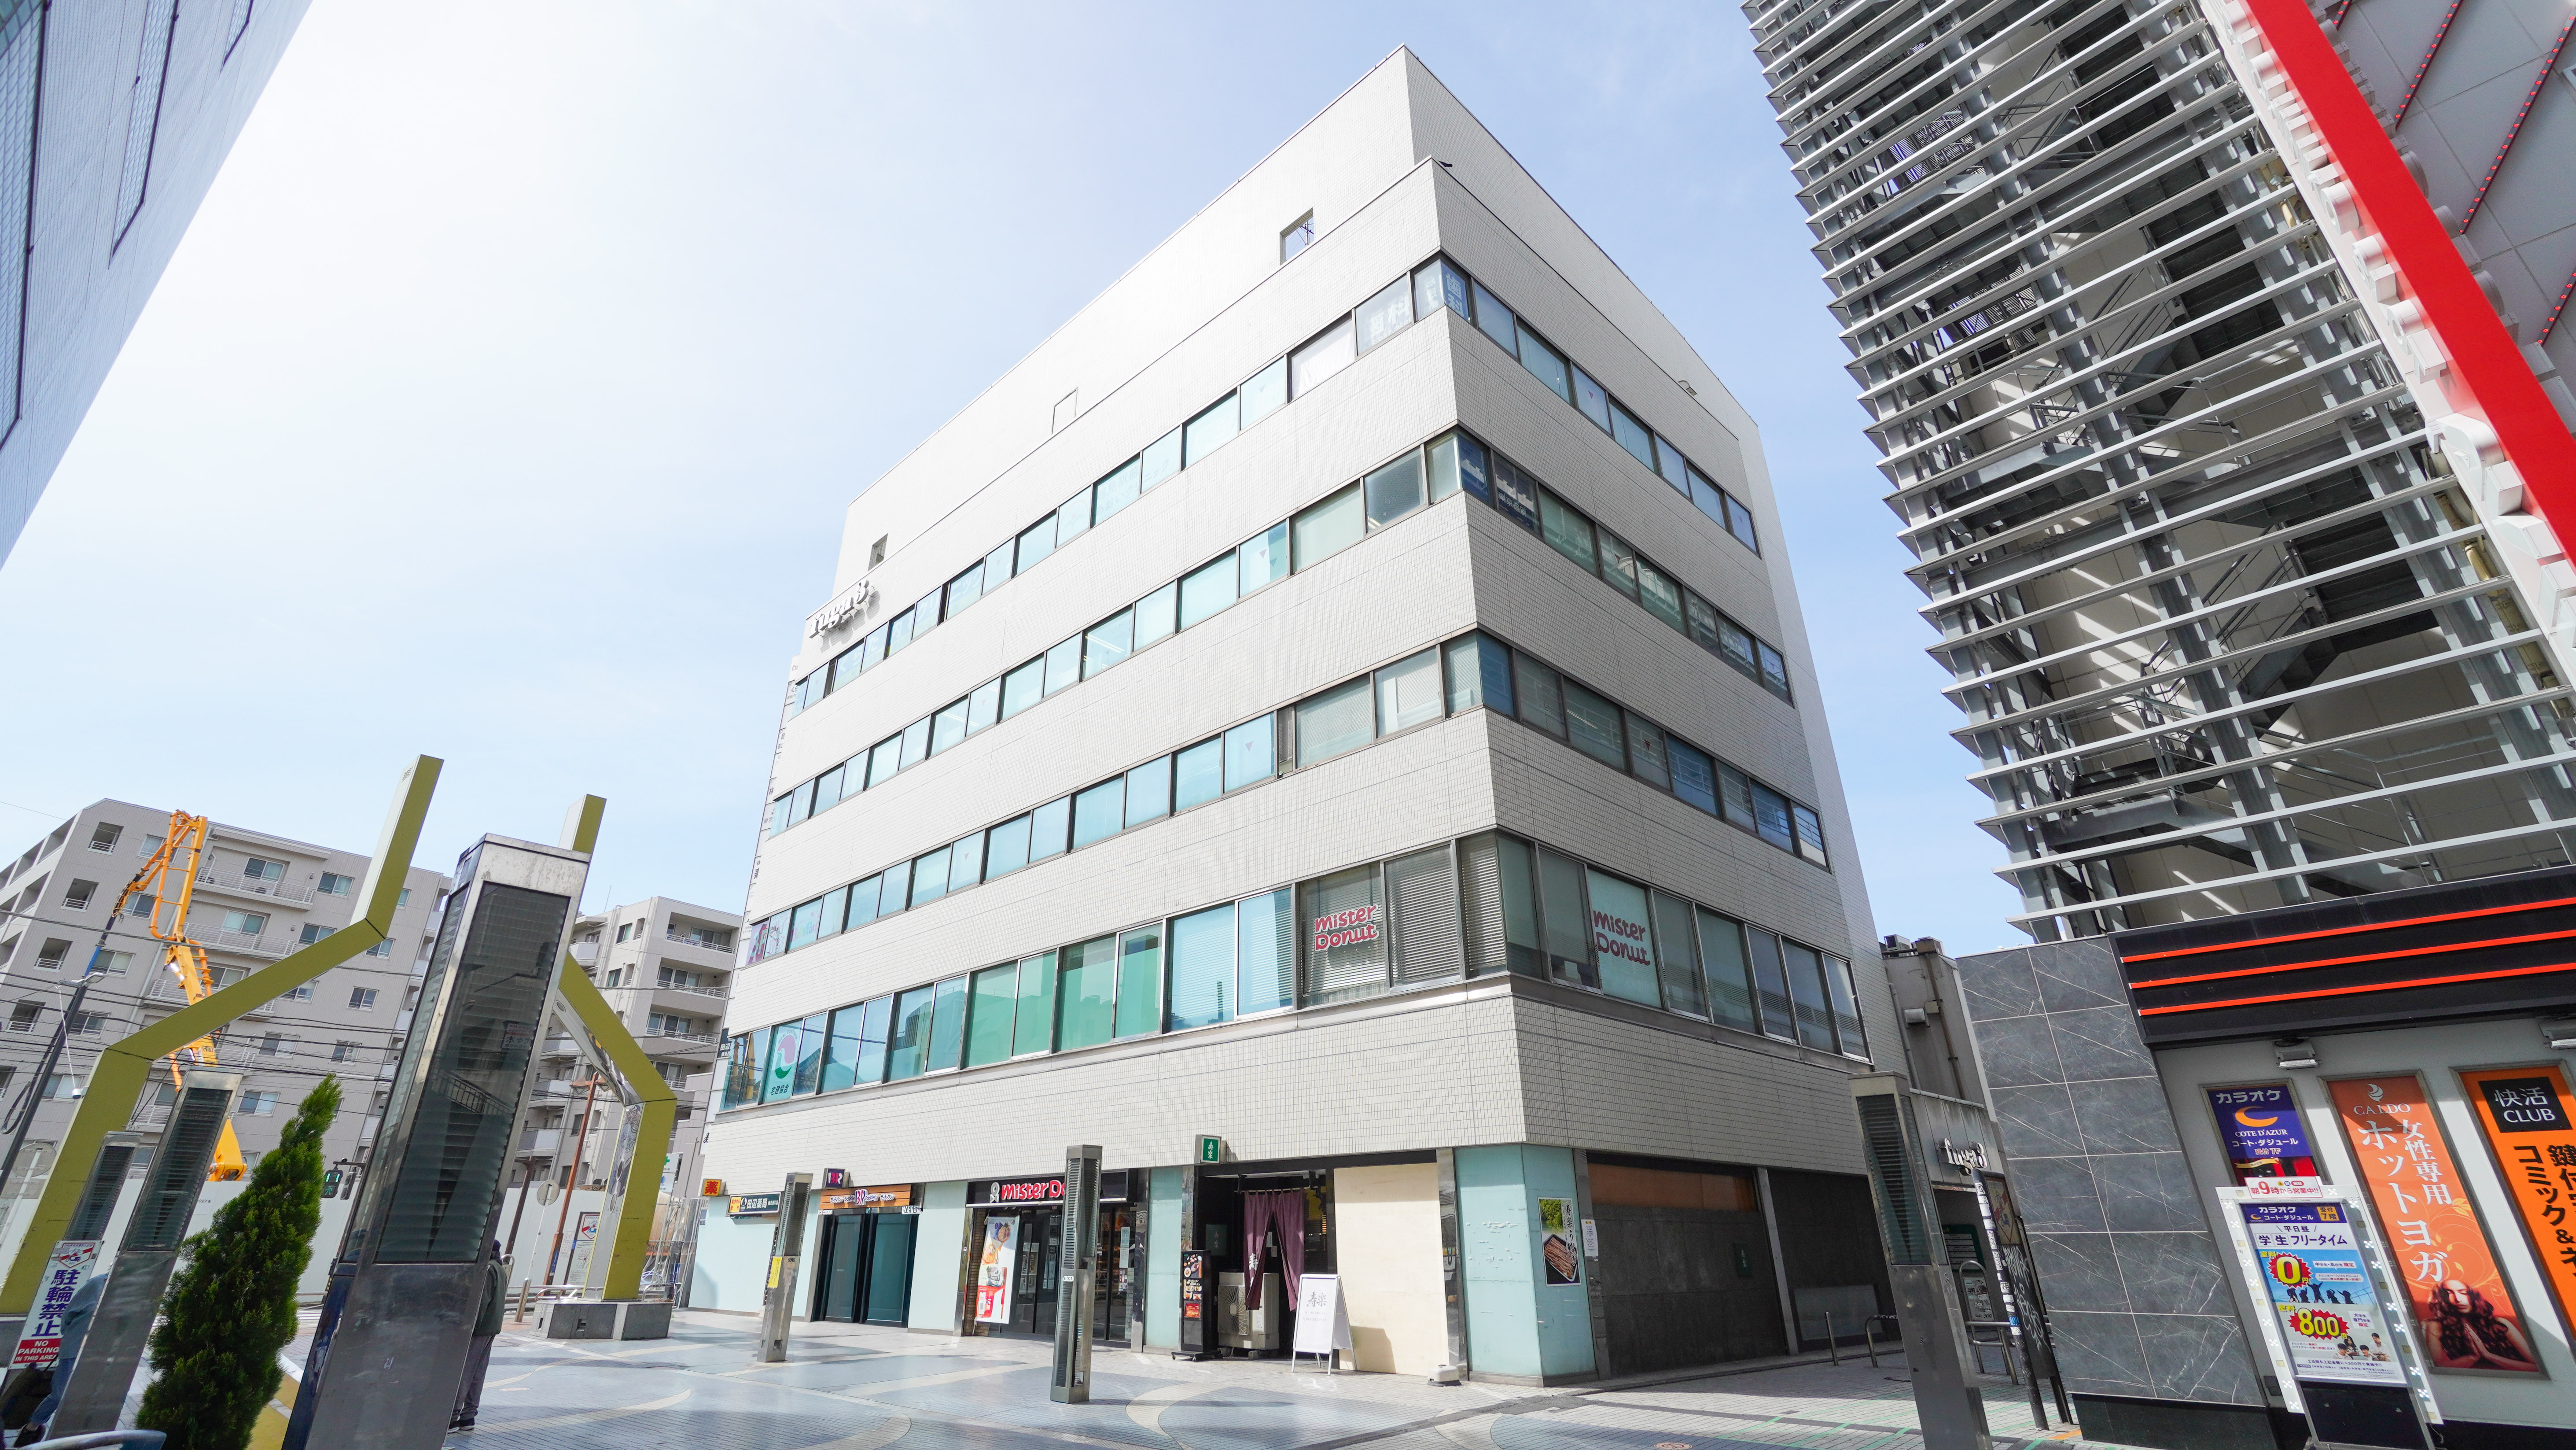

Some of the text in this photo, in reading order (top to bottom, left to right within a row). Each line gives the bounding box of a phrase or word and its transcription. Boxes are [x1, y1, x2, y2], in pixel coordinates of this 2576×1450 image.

[1314, 923, 1380, 951] Donut
[1596, 932, 1651, 966] Donut
[2216, 1089, 2281, 1104] カラオケ
[2494, 1087, 2548, 1107] 快活
[2353, 1103, 2411, 1115] CALDO
[2503, 1108, 2556, 1123] CLUB
[1207, 1141, 1214, 1159] 寿楽
[2232, 1138, 2299, 1147] コート・ダジュール
[1944, 1138, 1987, 1176] fuga3
[2396, 1119, 2453, 1206] 女性専用
[704, 1181, 719, 1195] 薬
[746, 1198, 768, 1209] 田辺薬局
[2358, 1120, 2448, 1282] ホットヨガ
[2258, 1234, 2348, 1246] 学生フリータイム
[31, 1269, 81, 1337] 駐輪禁止
[1308, 1291, 1327, 1307] 寿楽
[18, 1346, 60, 1354] PARKING
